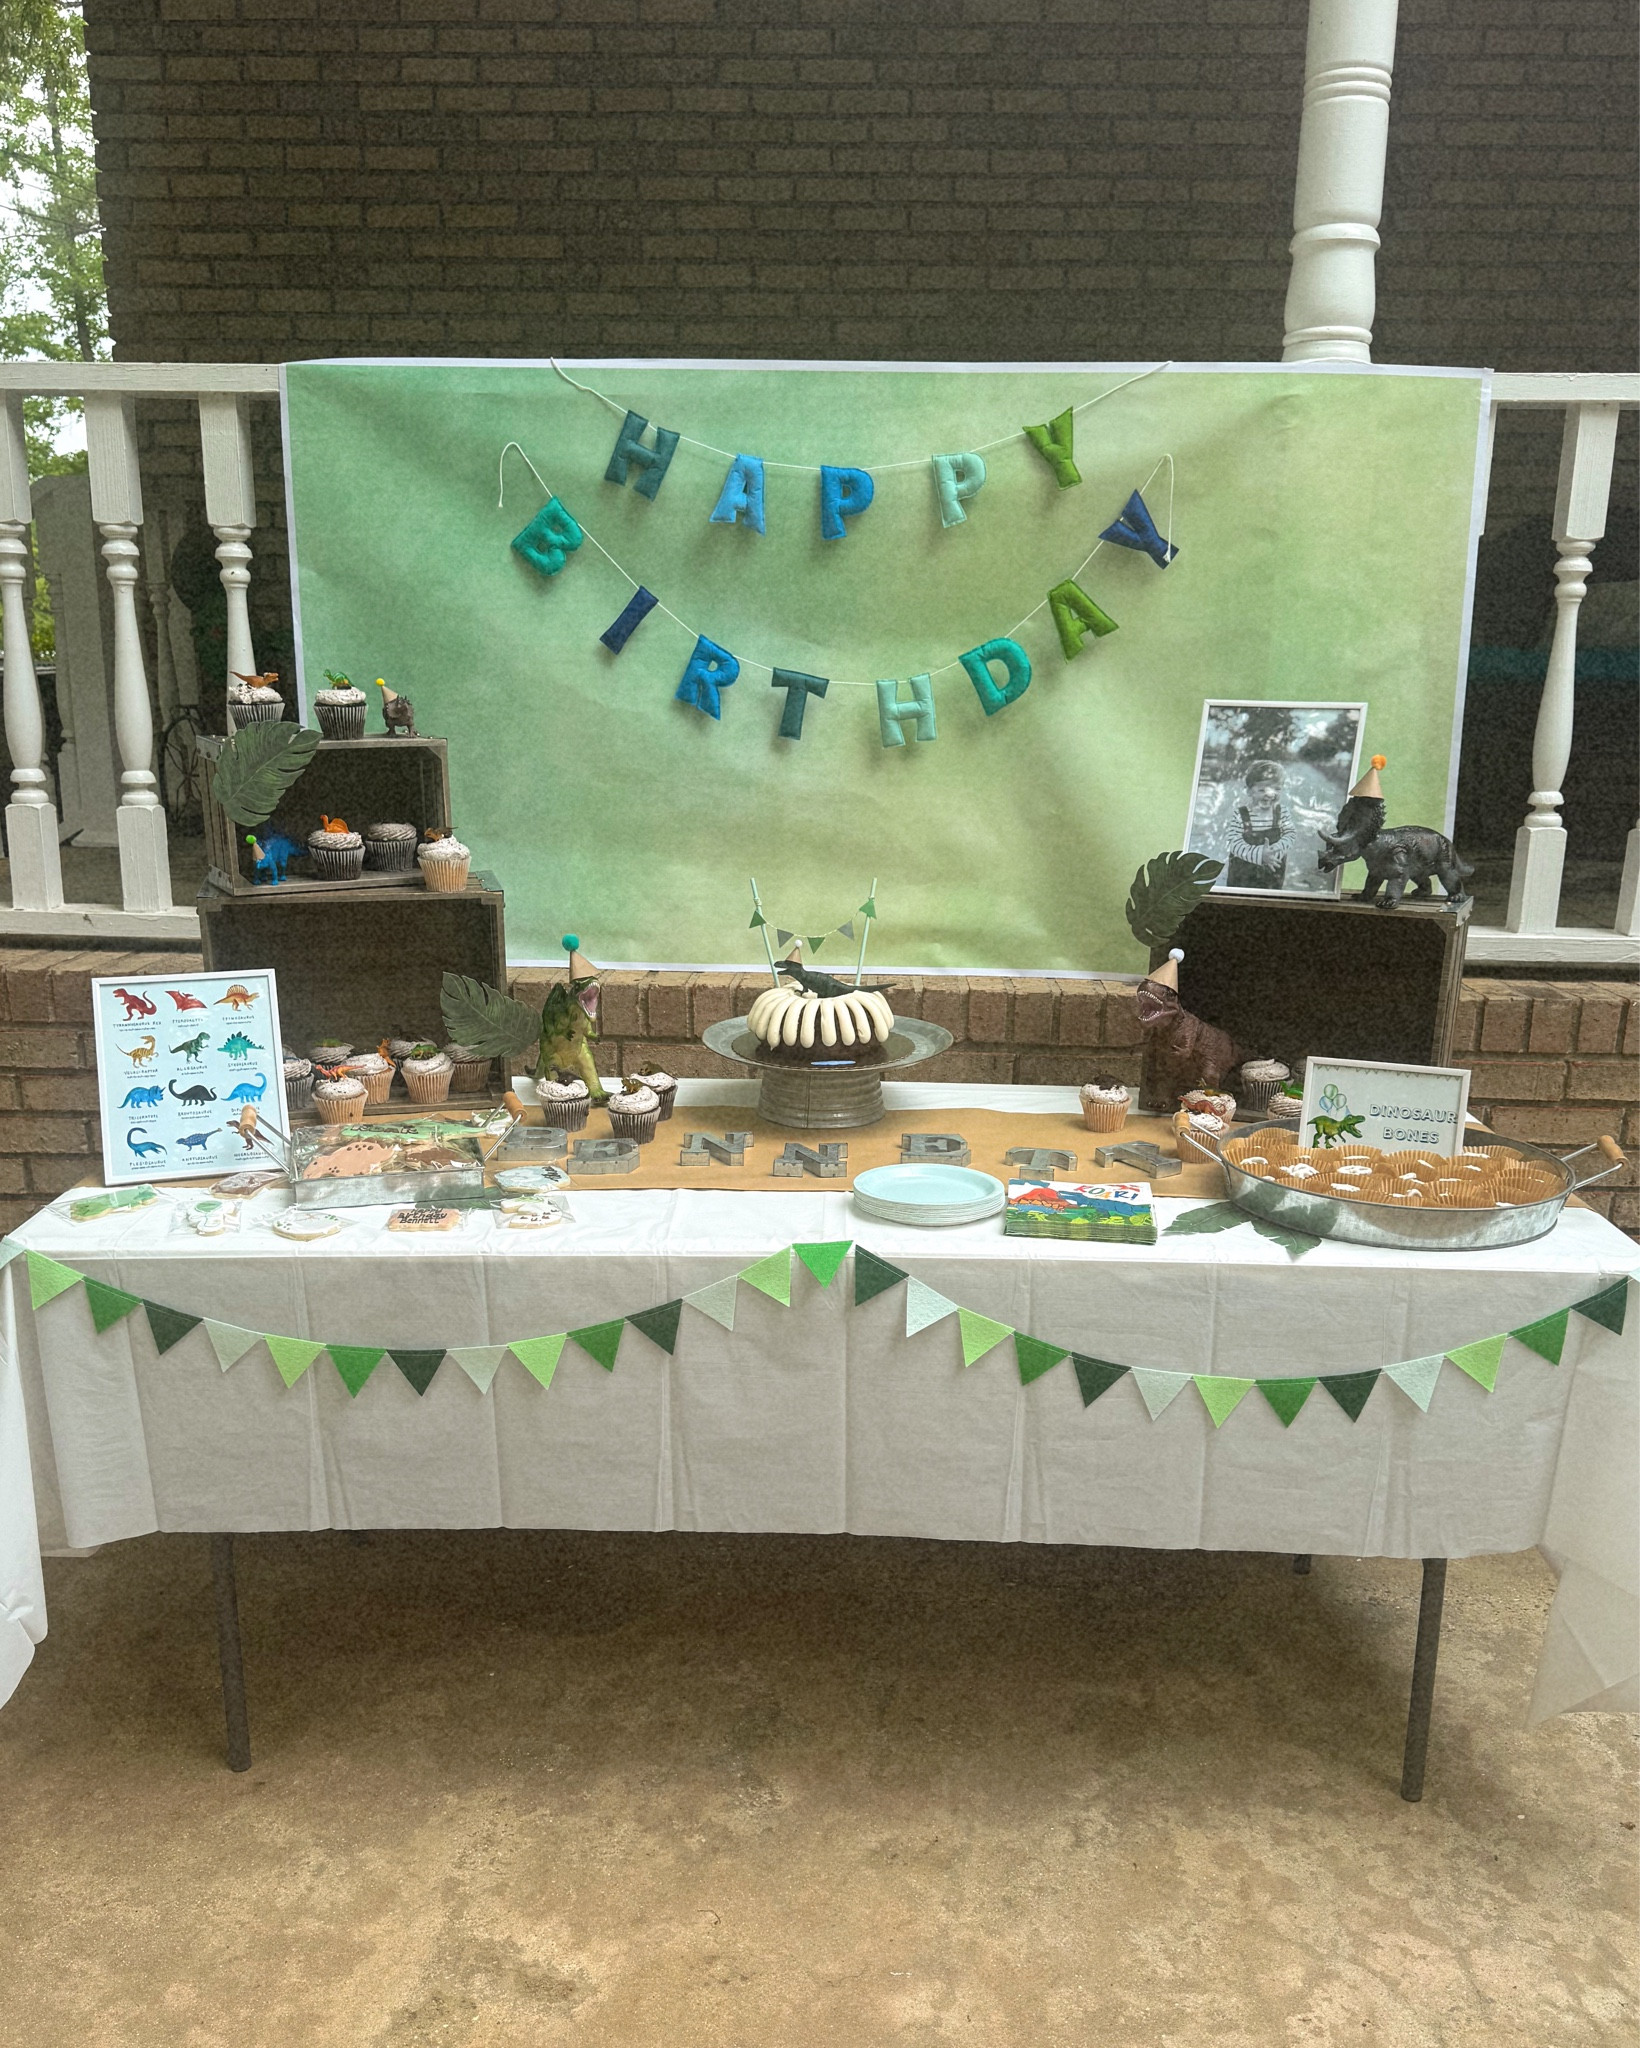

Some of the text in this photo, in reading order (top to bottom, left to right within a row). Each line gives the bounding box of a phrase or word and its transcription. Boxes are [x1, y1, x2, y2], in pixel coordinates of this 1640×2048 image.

[604, 406, 1083, 540] HAPPY
[510, 489, 1180, 748] BIRTHDAY
[1369, 1103, 1458, 1125] DINOSAUR
[1382, 1126, 1440, 1145] BONES
